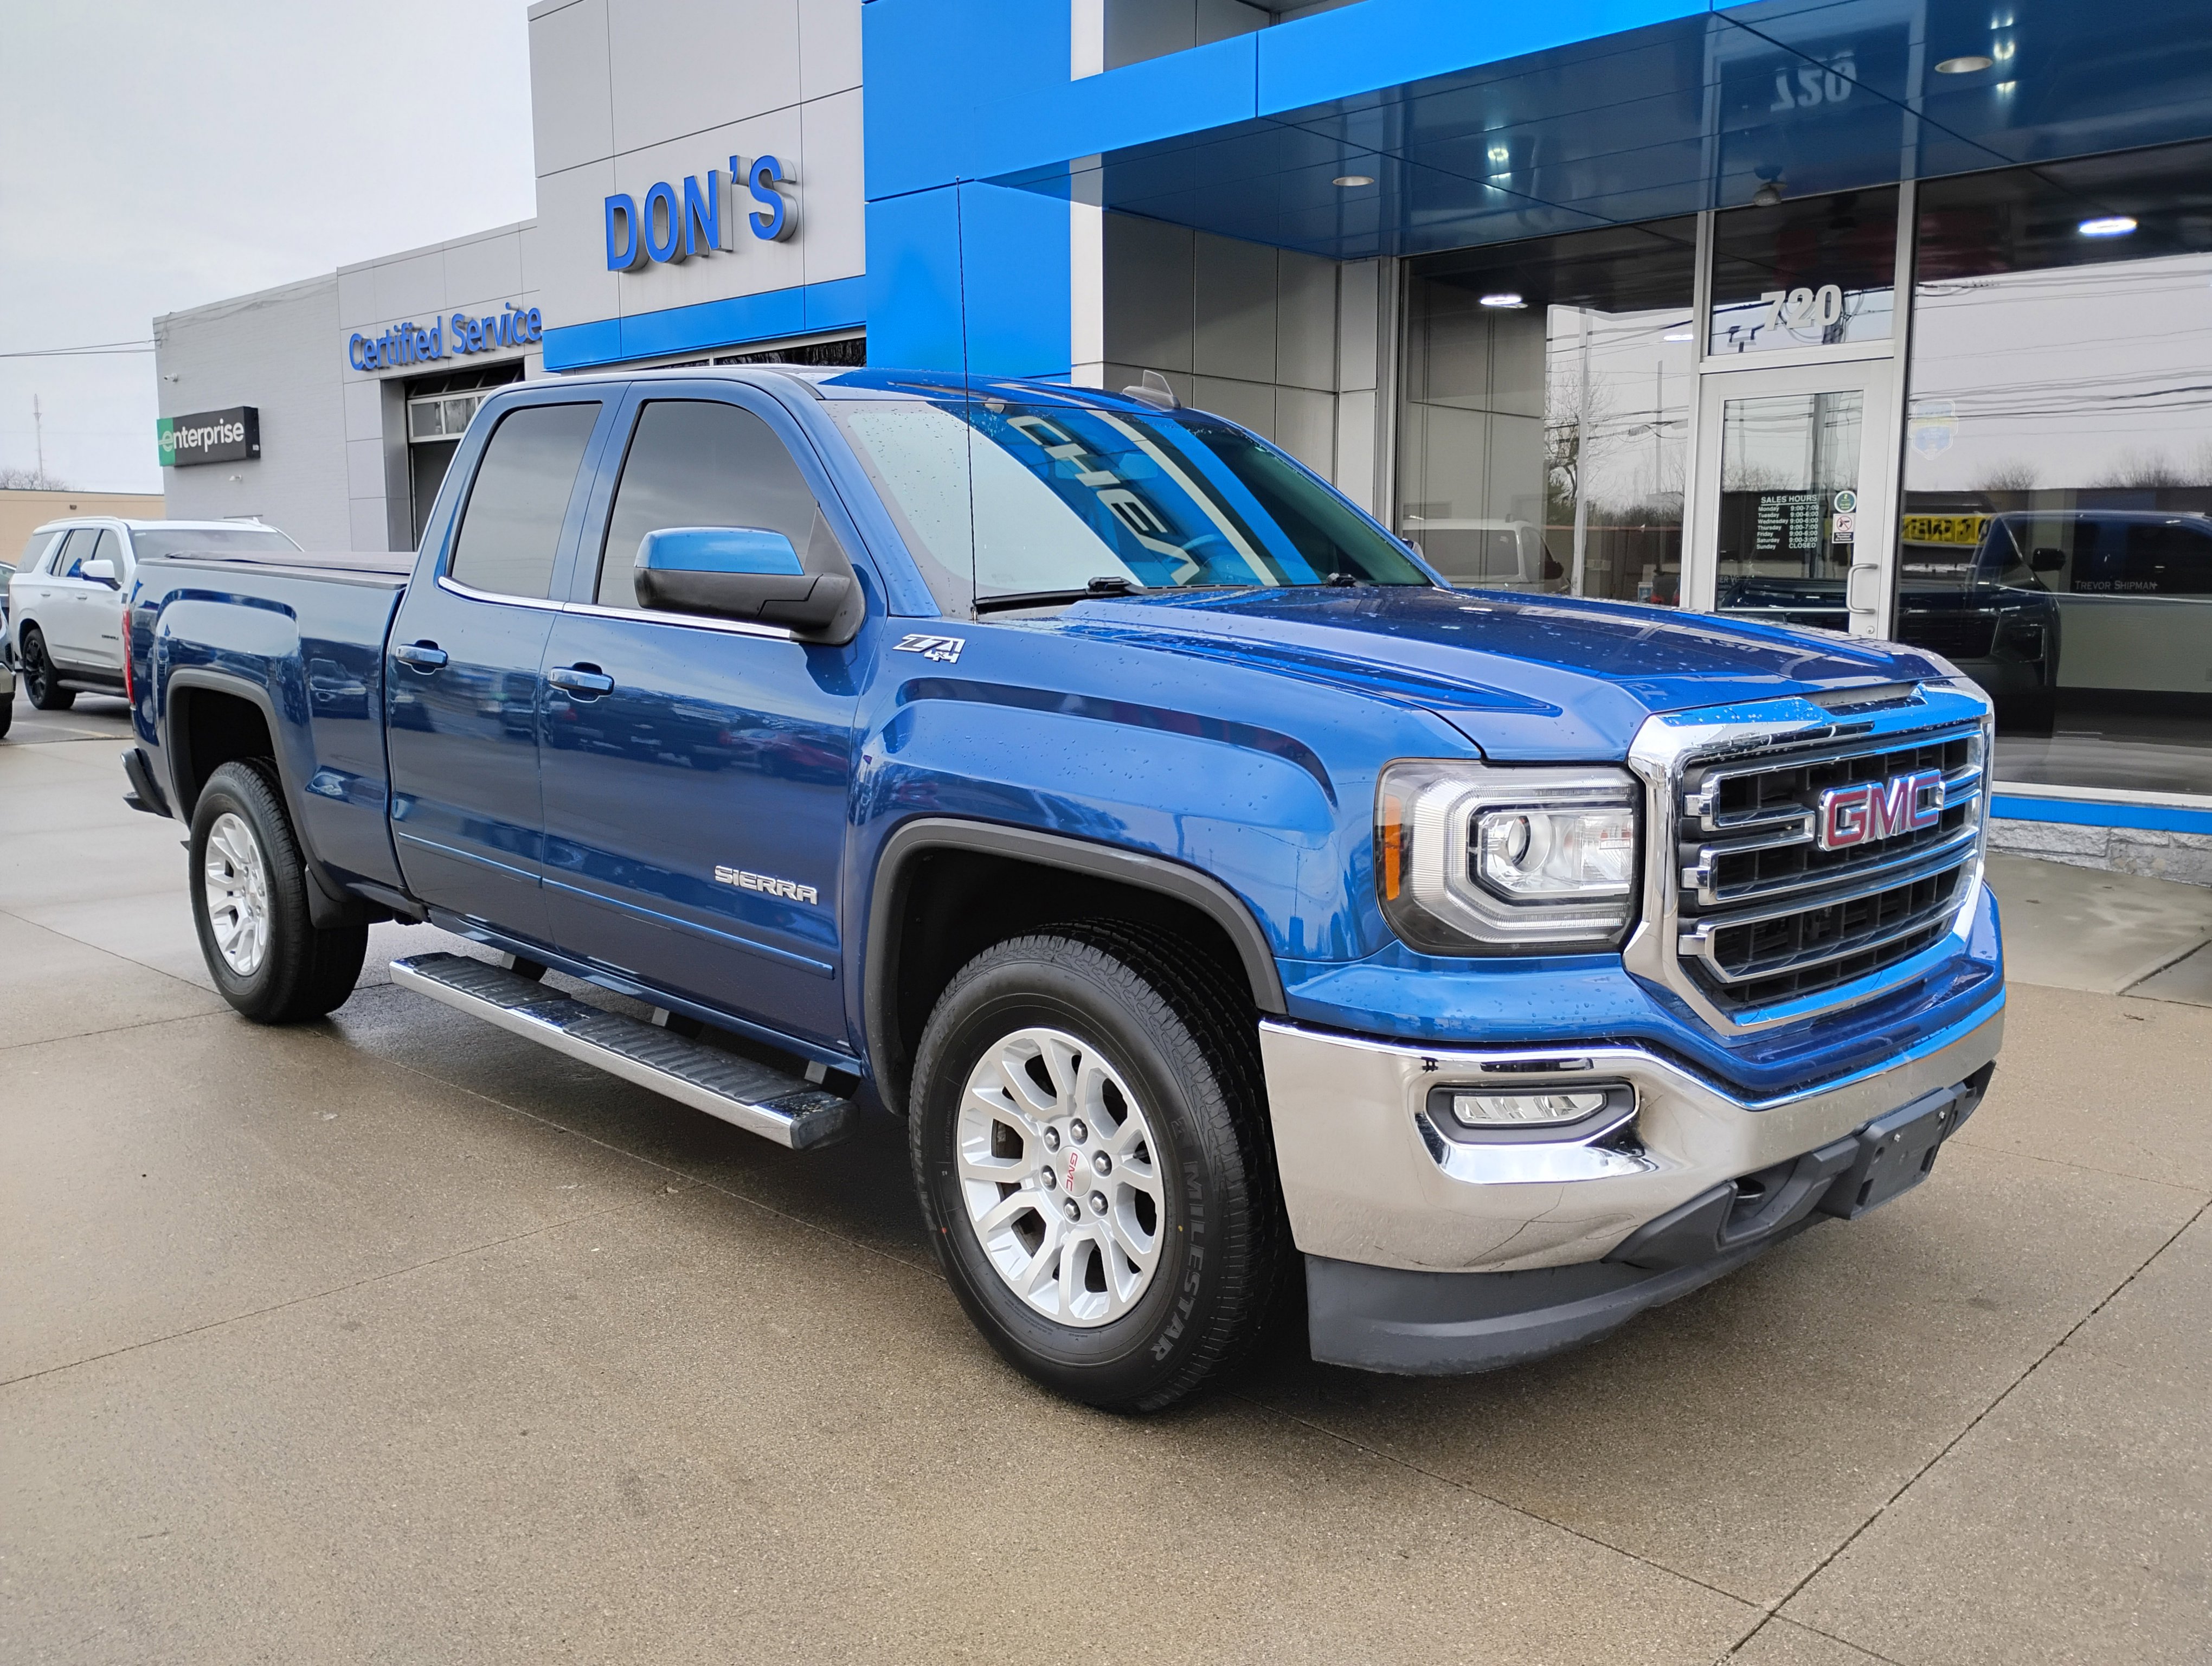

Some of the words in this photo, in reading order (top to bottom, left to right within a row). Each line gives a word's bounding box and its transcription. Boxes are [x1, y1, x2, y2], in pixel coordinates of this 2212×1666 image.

[605, 155, 795, 271] DON'S
[1760, 284, 1842, 332] 720
[349, 316, 443, 371] Certified
[451, 302, 543, 354] Service
[160, 418, 245, 453] enterprise
[1761, 496, 1787, 504] SALES
[2075, 580, 2111, 590] TREVOR
[892, 633, 966, 653] Z71
[1818, 768, 1942, 852] GMC
[714, 865, 818, 906] SIERRA
[1065, 1152, 1078, 1192] GMC
[1150, 1160, 1205, 1361] MILESTAR
